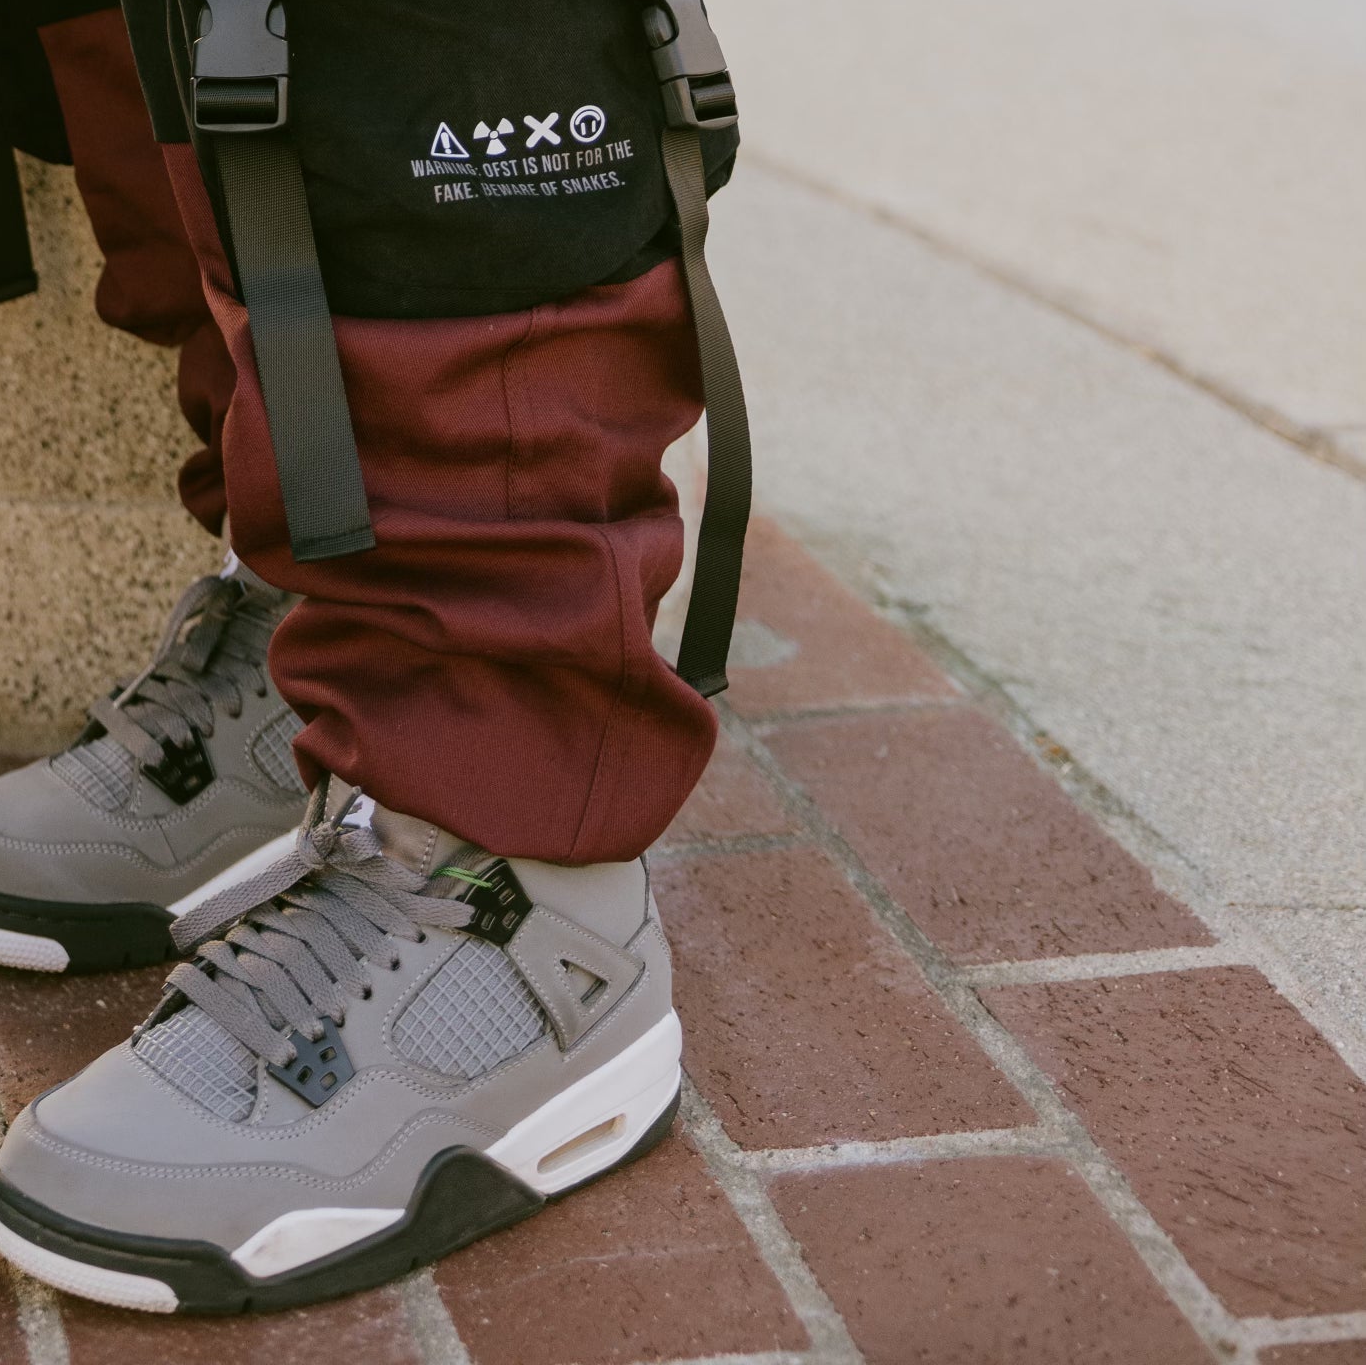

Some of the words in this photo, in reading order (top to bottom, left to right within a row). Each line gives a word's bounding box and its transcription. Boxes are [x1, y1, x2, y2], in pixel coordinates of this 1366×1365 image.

[410, 159, 481, 178] WARNING:
[484, 159, 519, 178] OFST
[523, 157, 538, 176] IS
[541, 152, 571, 174] NOT
[576, 147, 603, 168] FOR
[606, 139, 634, 161] THE
[434, 181, 479, 203] FAKE.
[483, 182, 539, 197] BEWARE
[540, 181, 560, 197] OF
[561, 171, 626, 195] SNAKES.
